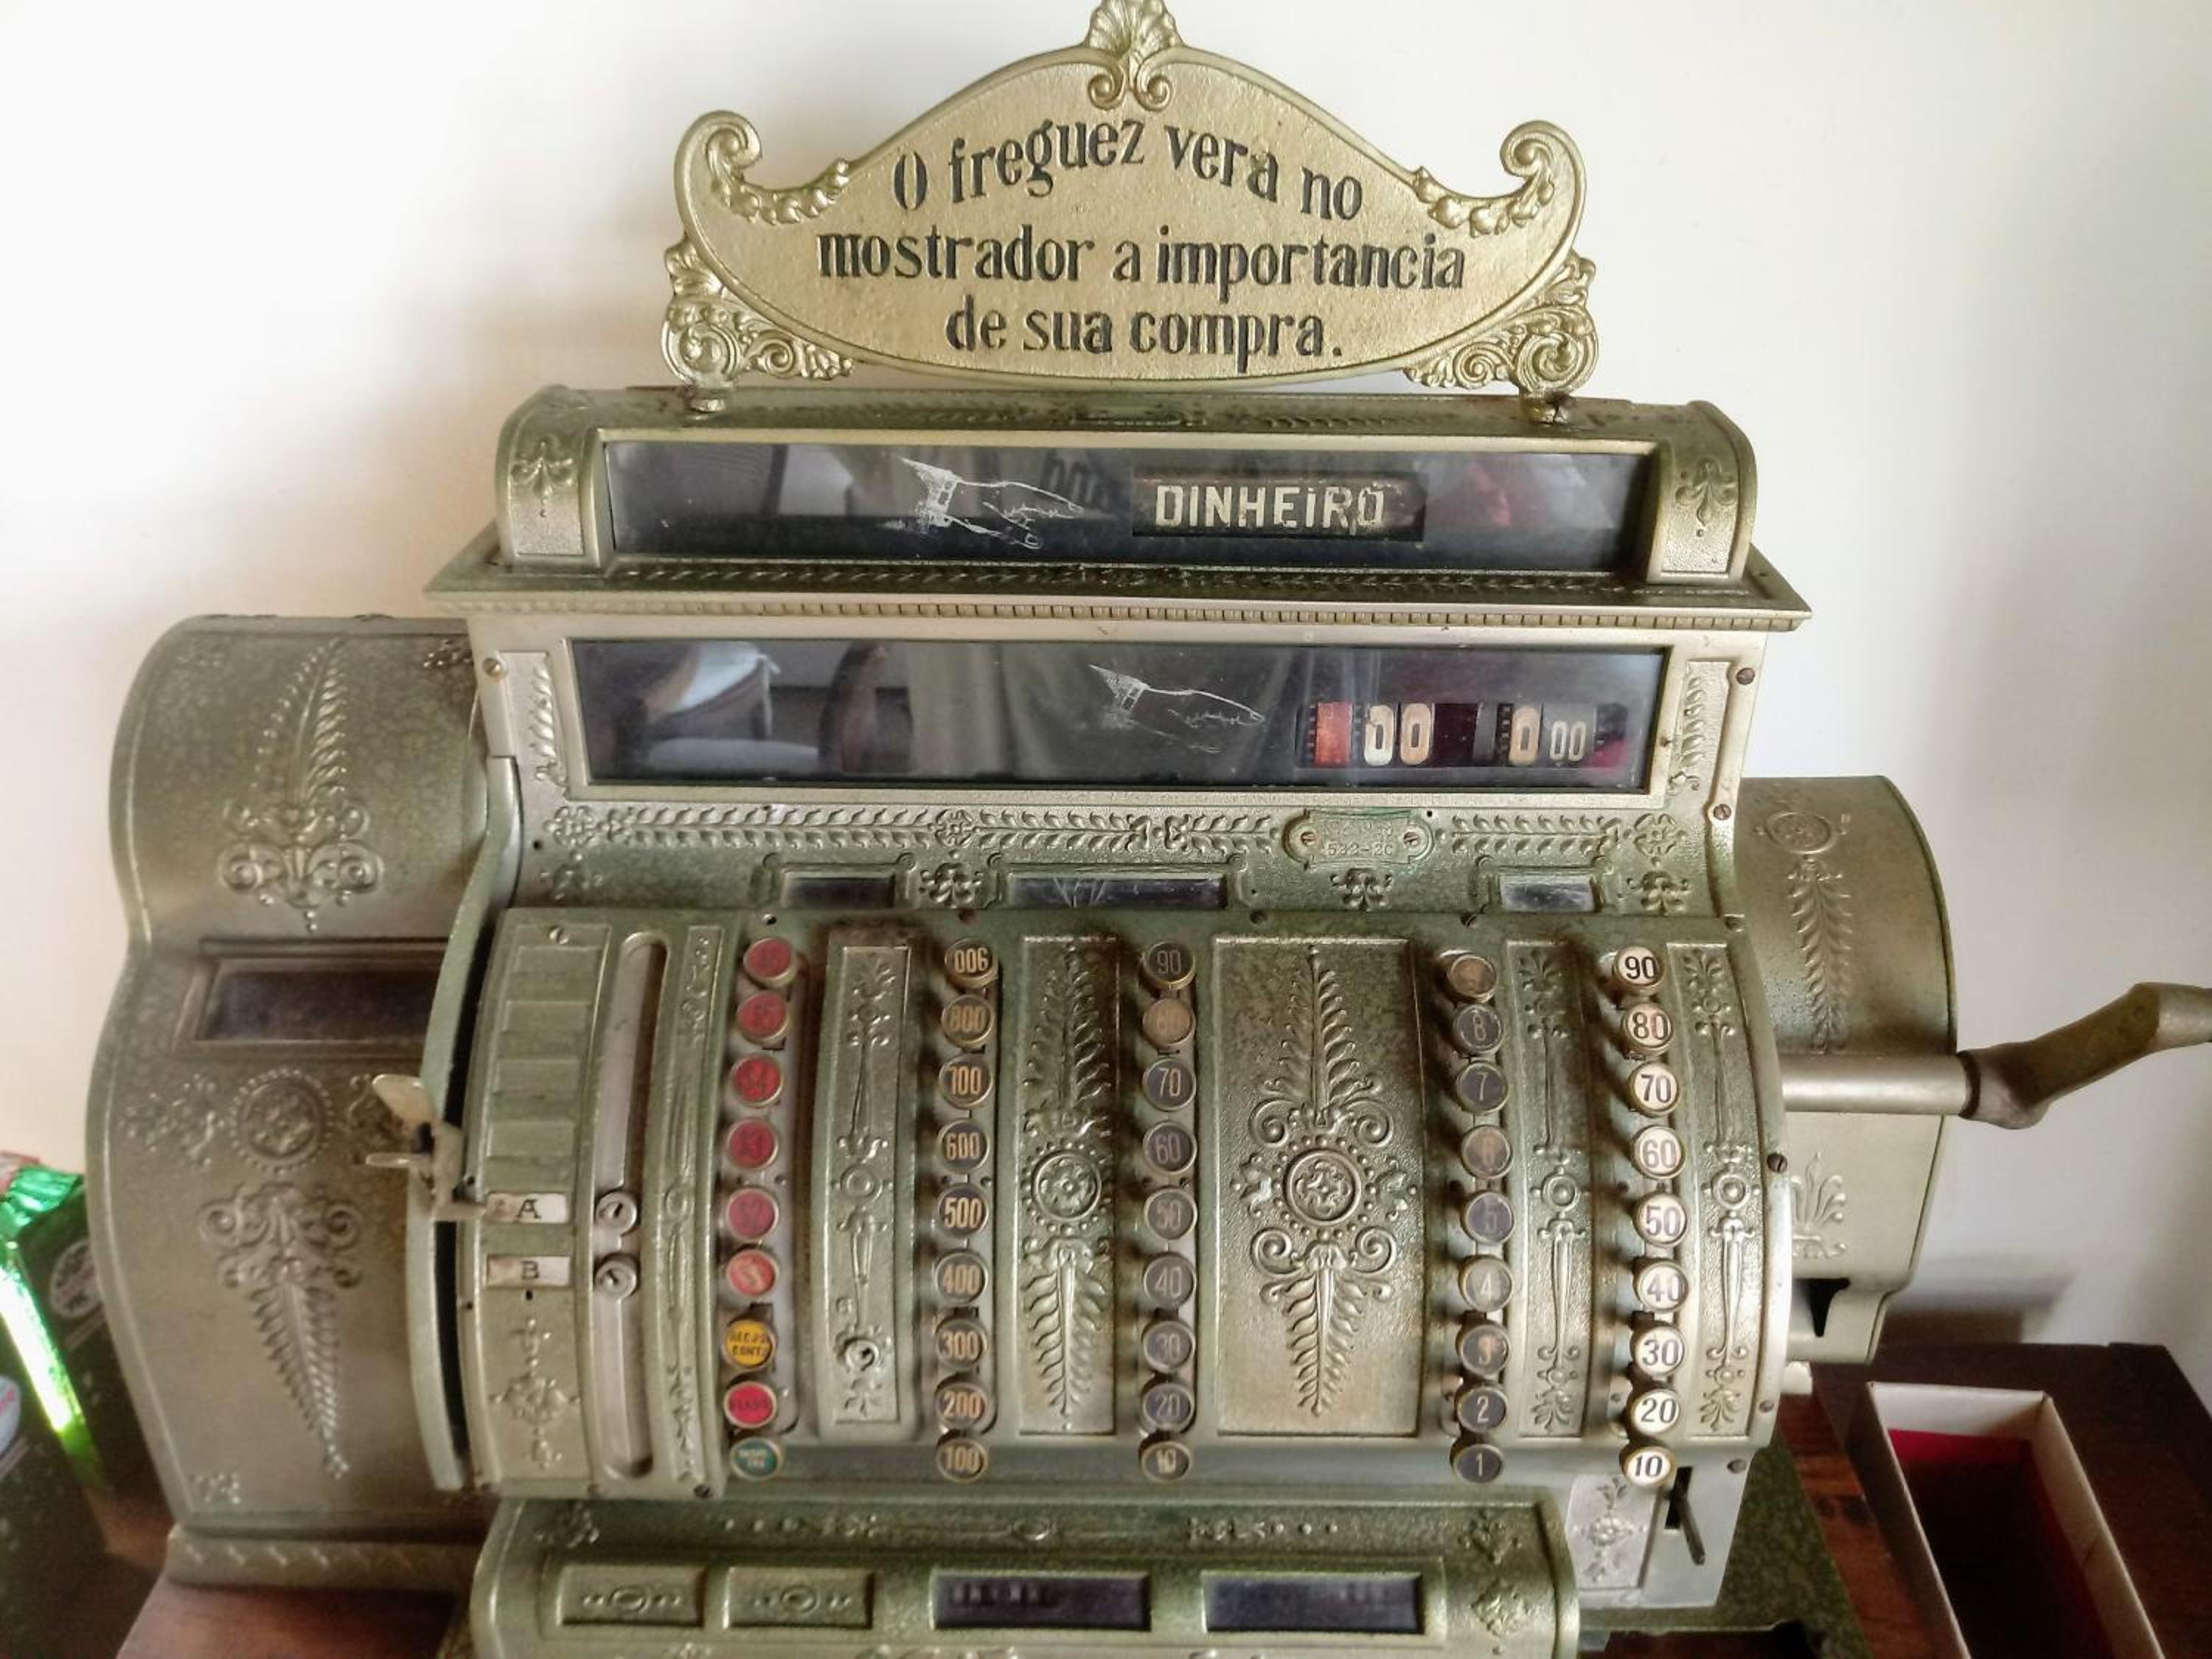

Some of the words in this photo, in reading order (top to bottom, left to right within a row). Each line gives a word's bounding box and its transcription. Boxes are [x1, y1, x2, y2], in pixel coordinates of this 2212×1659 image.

[894, 150, 928, 210] O
[949, 119, 1144, 204] freguez
[1164, 125, 1279, 203] vera
[1300, 166, 1363, 220] no
[816, 224, 1096, 281] mostrador
[1113, 240, 1141, 282] a
[1157, 225, 1465, 303] importancia
[946, 294, 1007, 352] de
[1023, 310, 1113, 354] sua
[1129, 312, 1342, 373] compra.
[1155, 484, 1385, 532] DINHEIRO
[1157, 950, 1180, 974] 90
[1624, 956, 1658, 980] 90
[1472, 1013, 1486, 1042] 8
[1632, 1012, 1669, 1040] 80
[1158, 1068, 1180, 1097] 70
[1477, 1071, 1487, 1101] 7
[1641, 1074, 1672, 1104] 70
[946, 1133, 981, 1161] 600
[1156, 1134, 1180, 1163] 60
[1642, 1139, 1677, 1169] 60
[518, 1199, 542, 1220] A
[945, 1197, 982, 1228] 500
[1645, 1205, 1681, 1237] 50
[521, 1260, 540, 1280] B
[943, 1265, 981, 1294] 400
[1155, 1265, 1182, 1298] 40
[1480, 1273, 1492, 1301] 4
[1646, 1273, 1683, 1303] 40
[943, 1332, 978, 1360] 300
[1155, 1333, 1180, 1360] 30
[1642, 1339, 1680, 1366] 30
[943, 1391, 979, 1418] 200
[1477, 1396, 1489, 1422] 2
[1641, 1398, 1676, 1424] 20
[945, 1447, 979, 1473] 100
[1475, 1453, 1484, 1477] 1
[1635, 1455, 1663, 1477] 10
